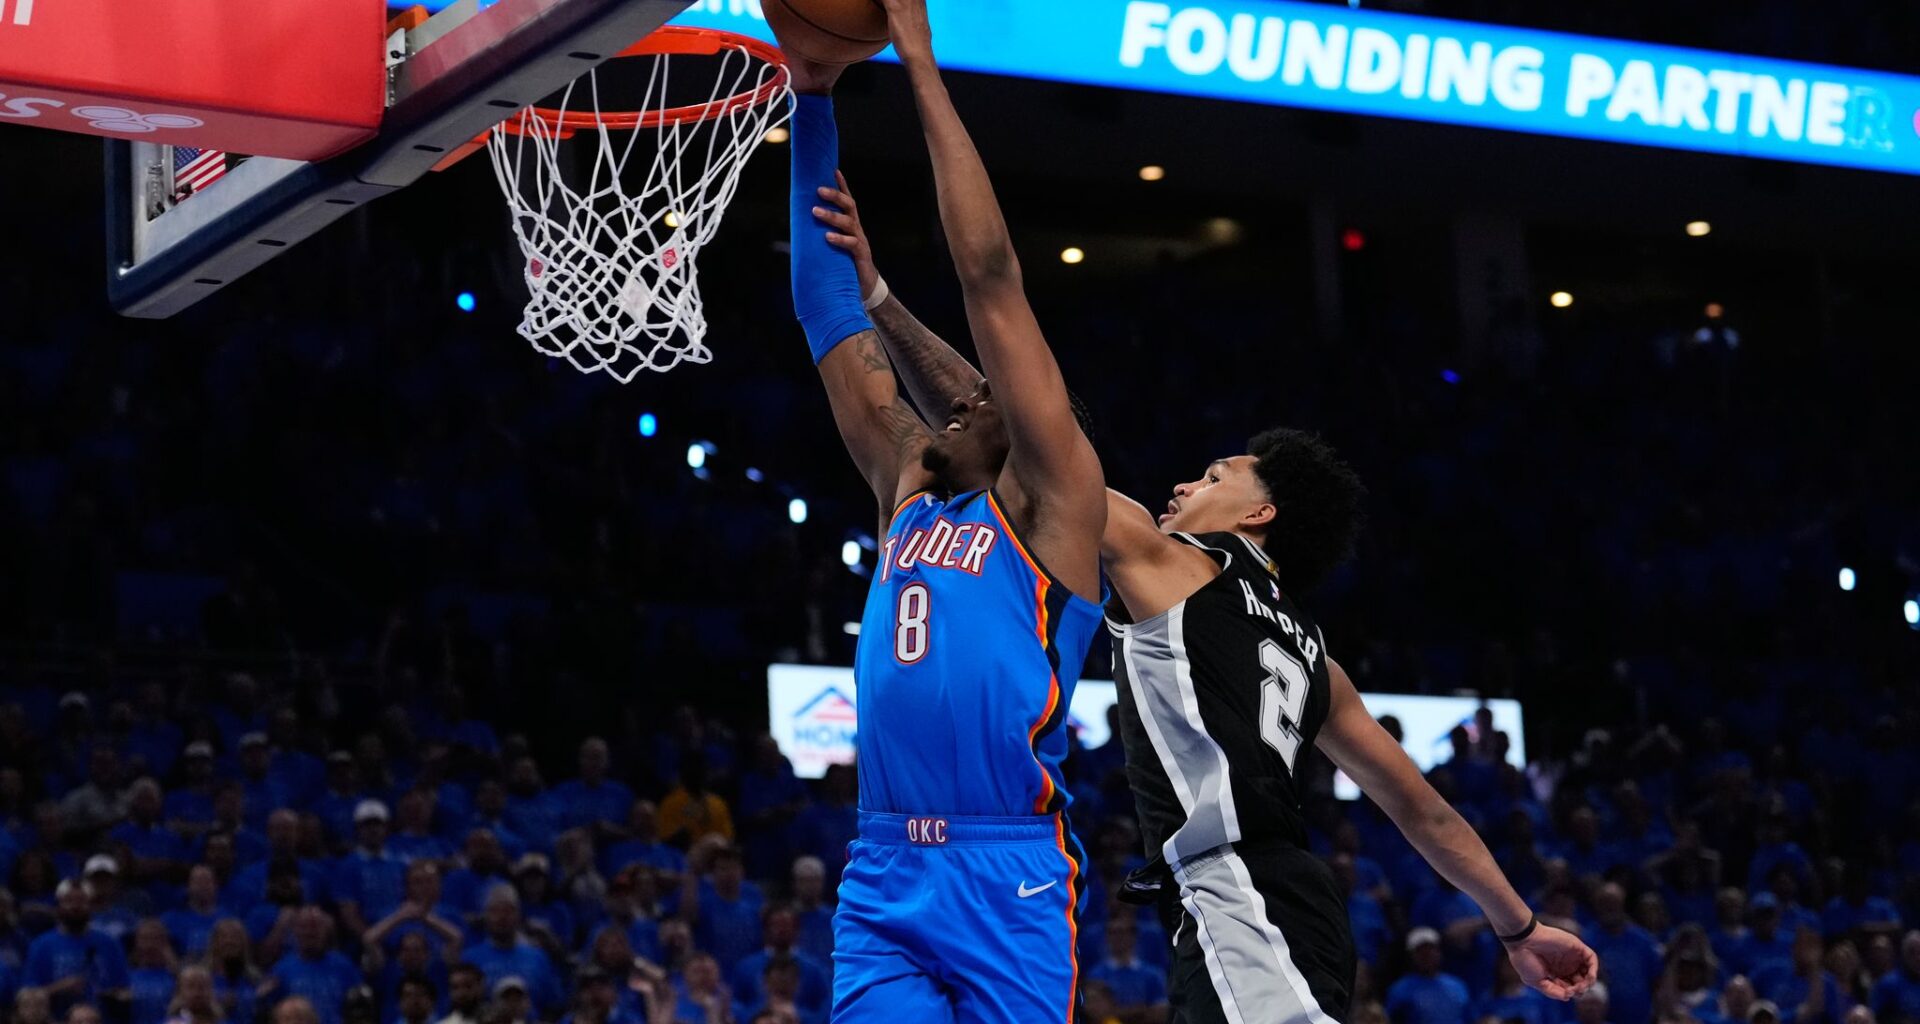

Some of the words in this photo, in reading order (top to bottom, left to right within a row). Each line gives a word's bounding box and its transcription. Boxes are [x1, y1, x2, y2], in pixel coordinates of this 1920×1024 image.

[1118, 0, 1544, 111] FOUNDING
[881, 515, 999, 585] TUDER
[894, 581, 931, 665] 8
[794, 727, 857, 748] HOM
[1258, 637, 1310, 778] 2
[907, 817, 949, 844] OKC
